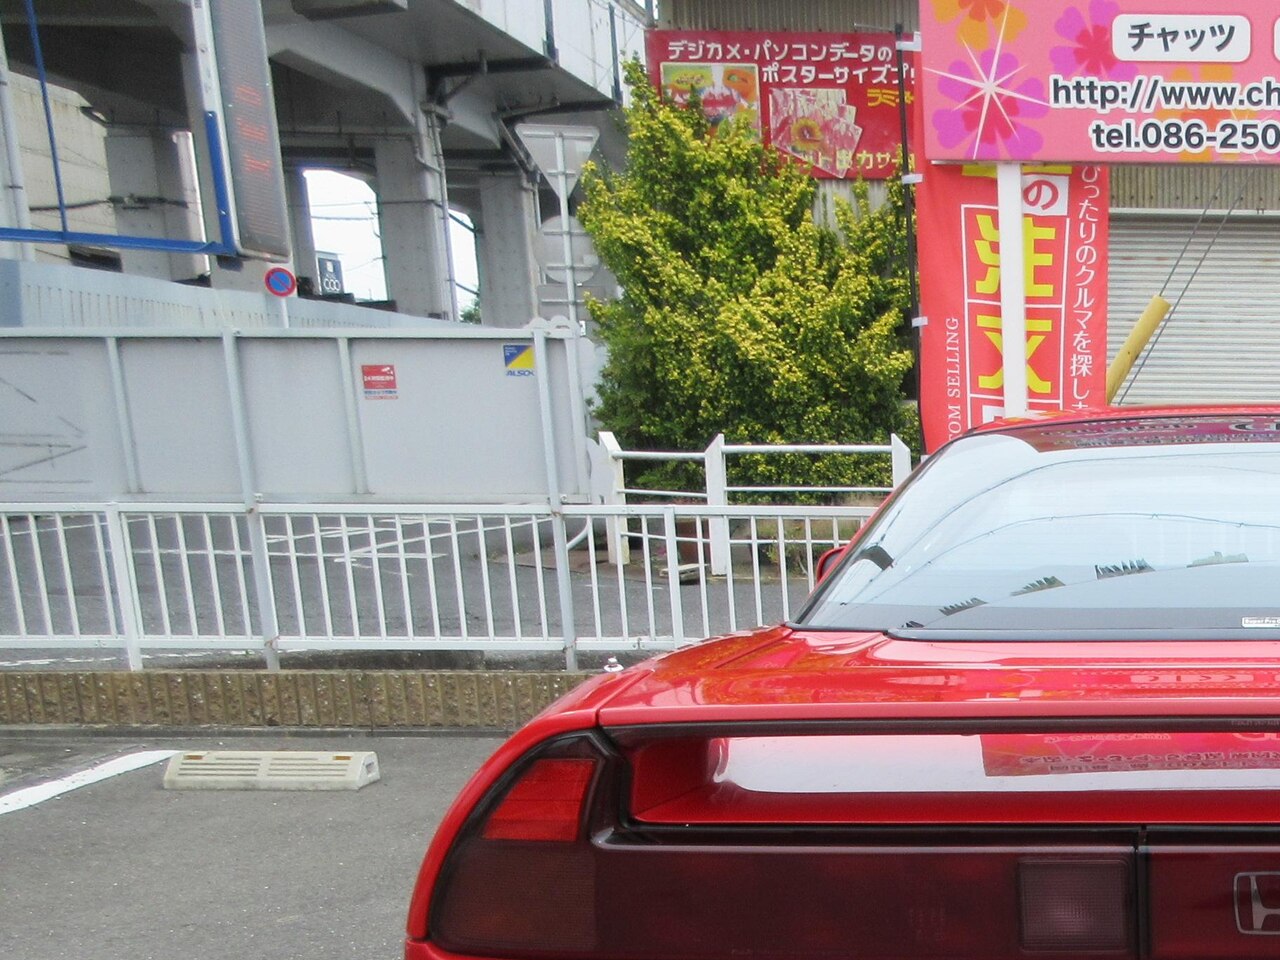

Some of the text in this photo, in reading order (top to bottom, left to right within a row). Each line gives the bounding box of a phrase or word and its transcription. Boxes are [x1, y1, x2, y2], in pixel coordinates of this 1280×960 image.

[667, 40, 893, 62] デジカメ・パソコンデータの
[1128, 22, 1236, 52] チャッツ
[945, 317, 960, 398] SELLING
